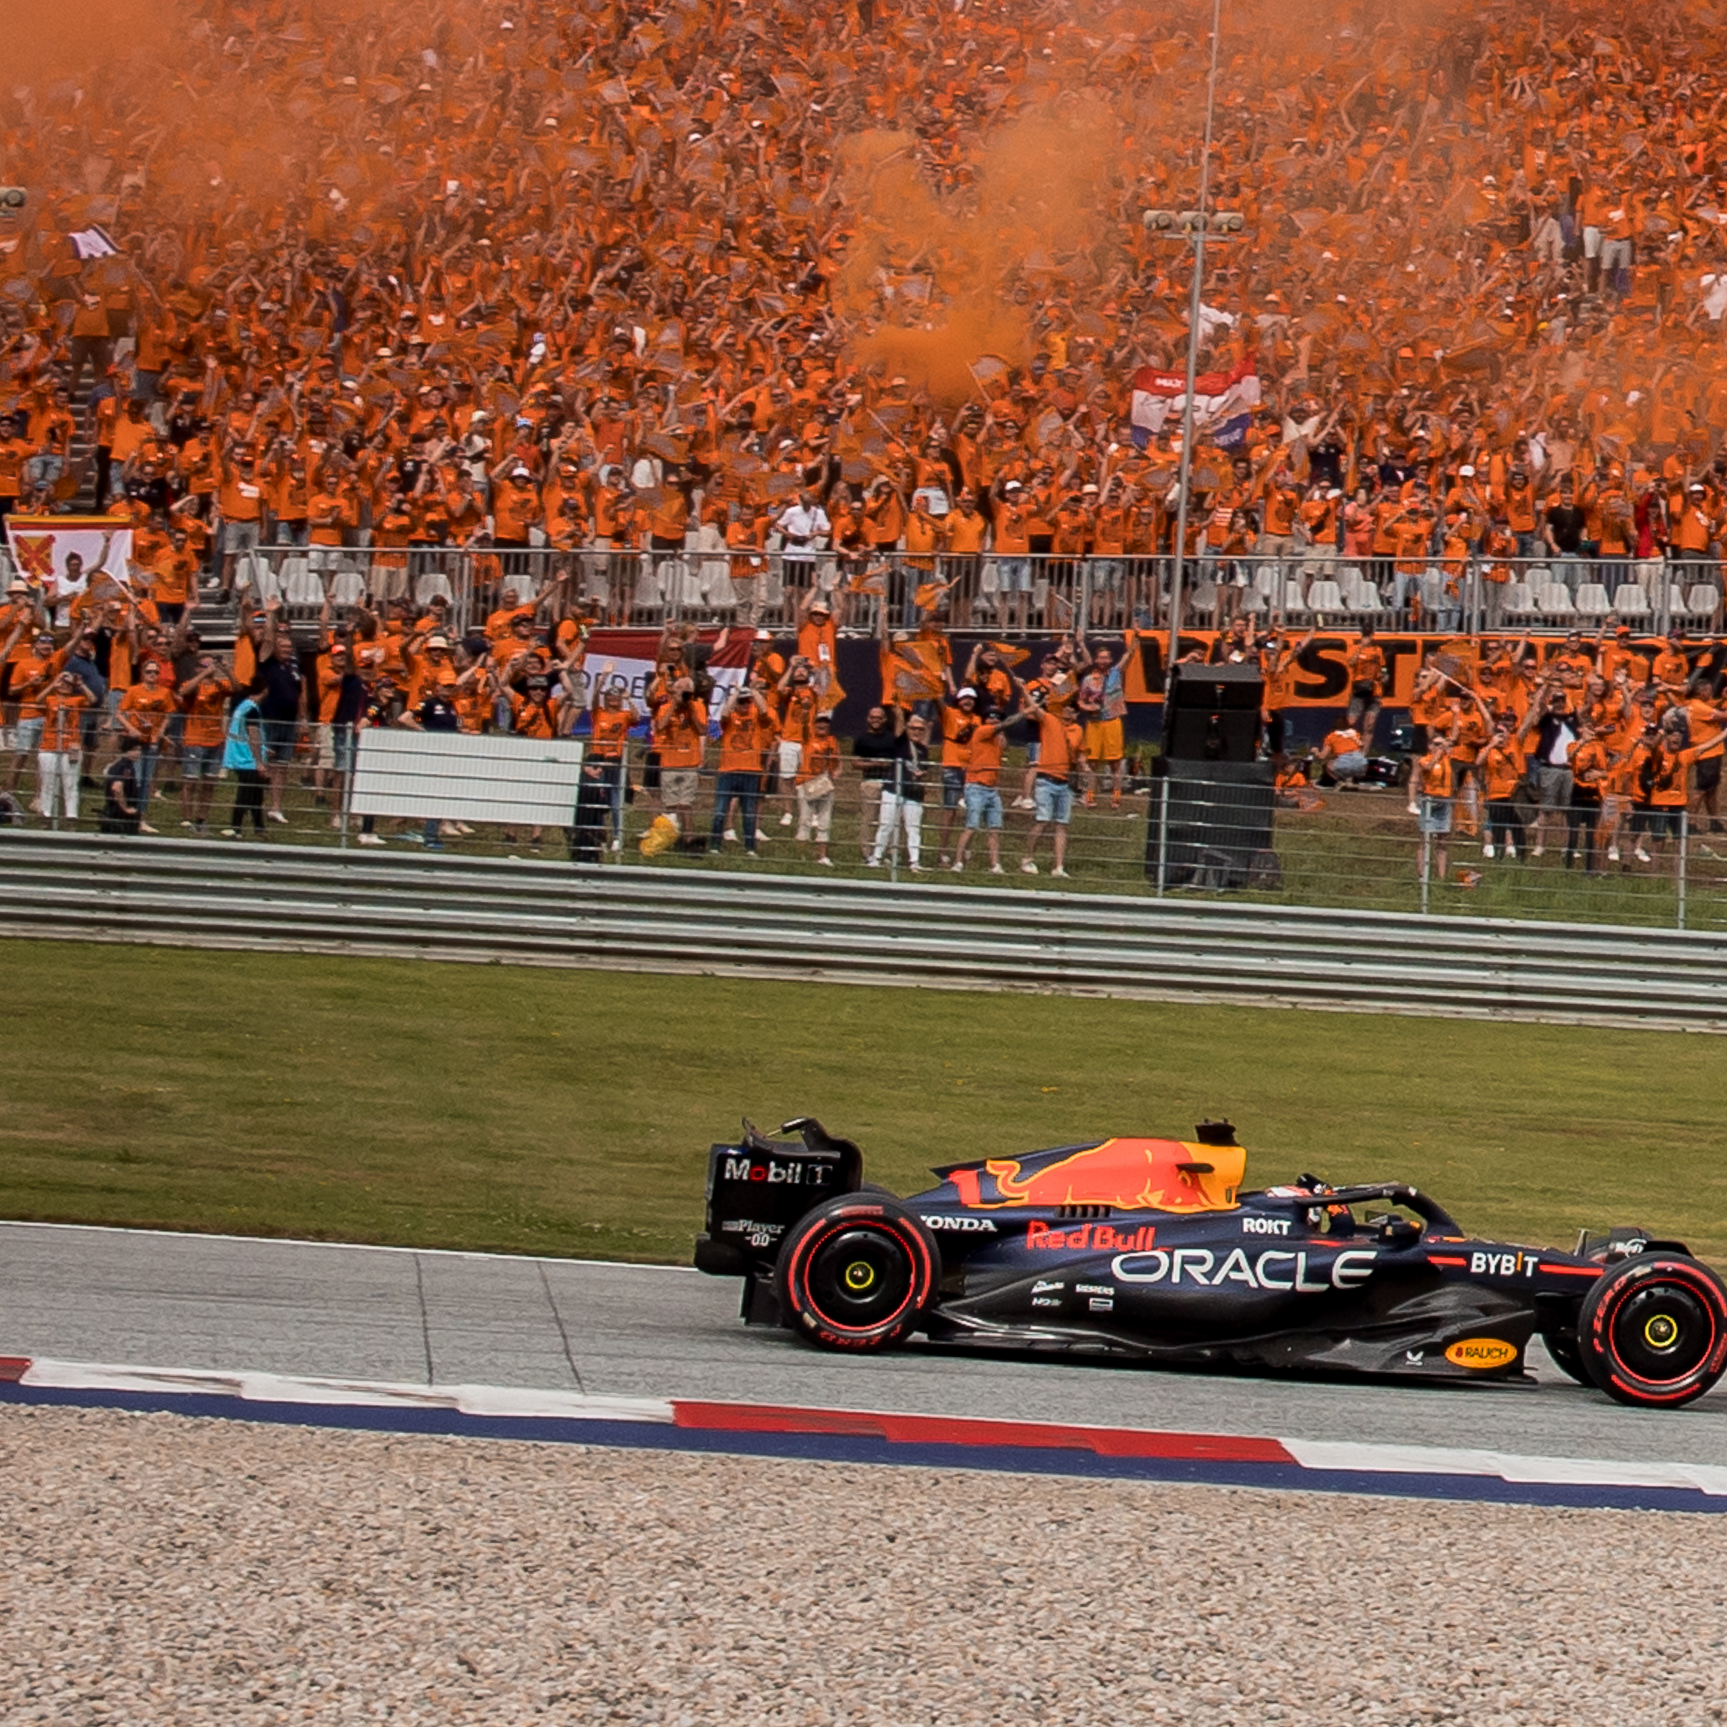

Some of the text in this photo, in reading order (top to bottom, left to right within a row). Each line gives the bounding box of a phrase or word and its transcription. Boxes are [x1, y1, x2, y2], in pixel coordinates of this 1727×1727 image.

[724, 1157, 801, 1184] Mobil
[738, 1219, 785, 1235] Player
[920, 1215, 998, 1232] ONDA
[1243, 1217, 1291, 1235] ROKT
[1111, 1248, 1378, 1292] ORACLE
[1470, 1251, 1539, 1277] BYBIT
[1465, 1346, 1508, 1360] RAUCH
